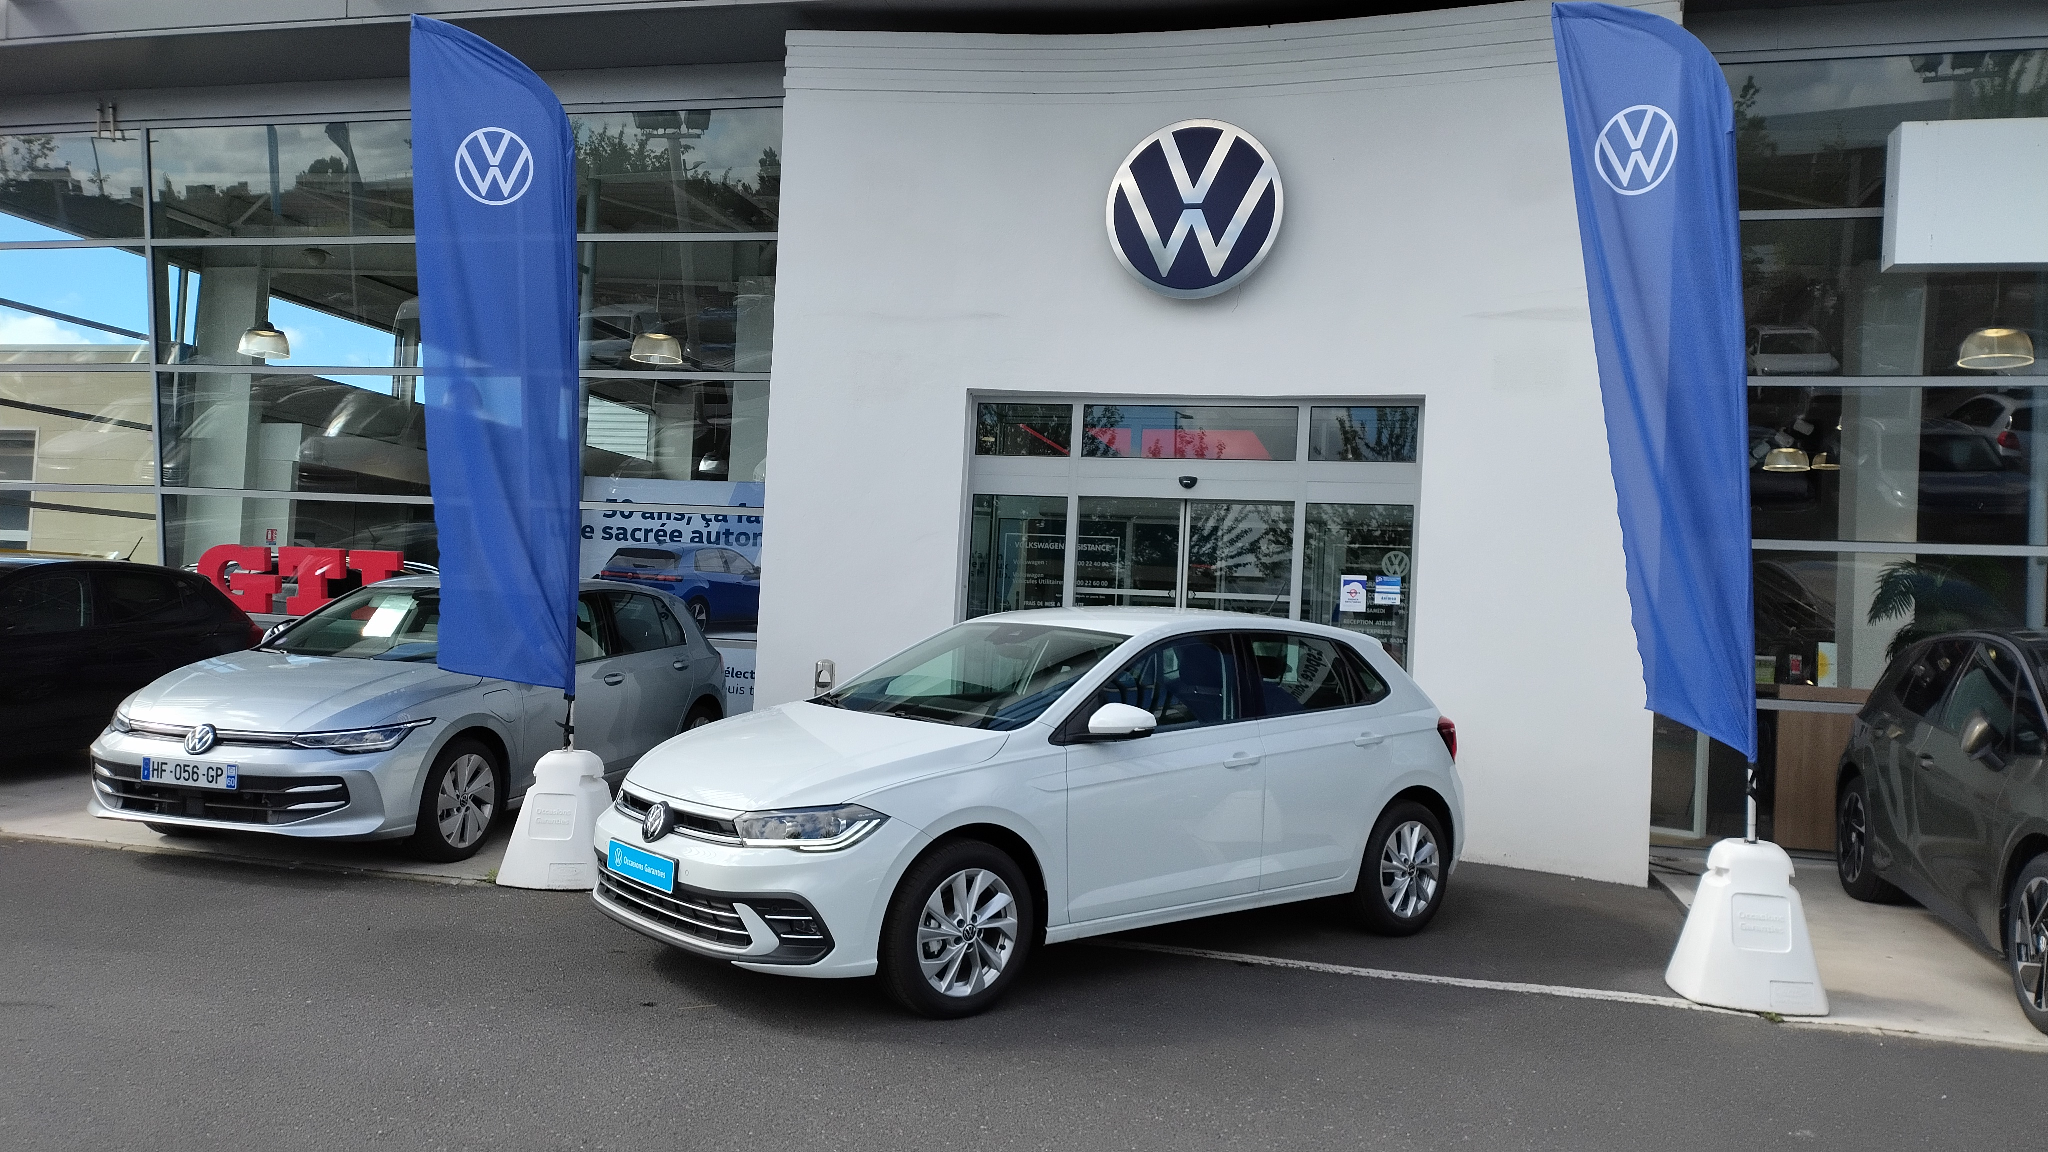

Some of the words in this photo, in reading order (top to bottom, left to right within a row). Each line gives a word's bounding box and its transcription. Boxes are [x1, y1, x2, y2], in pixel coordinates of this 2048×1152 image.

[1106, 118, 1283, 299] VW
[600, 523, 683, 544] sacrée
[1014, 541, 1064, 550] VOLKSWAGEN
[197, 544, 404, 615] GTI
[726, 684, 745, 695] uis
[227, 777, 235, 787] 60
[623, 856, 644, 871] Occasions
[644, 863, 666, 879] Garanties
